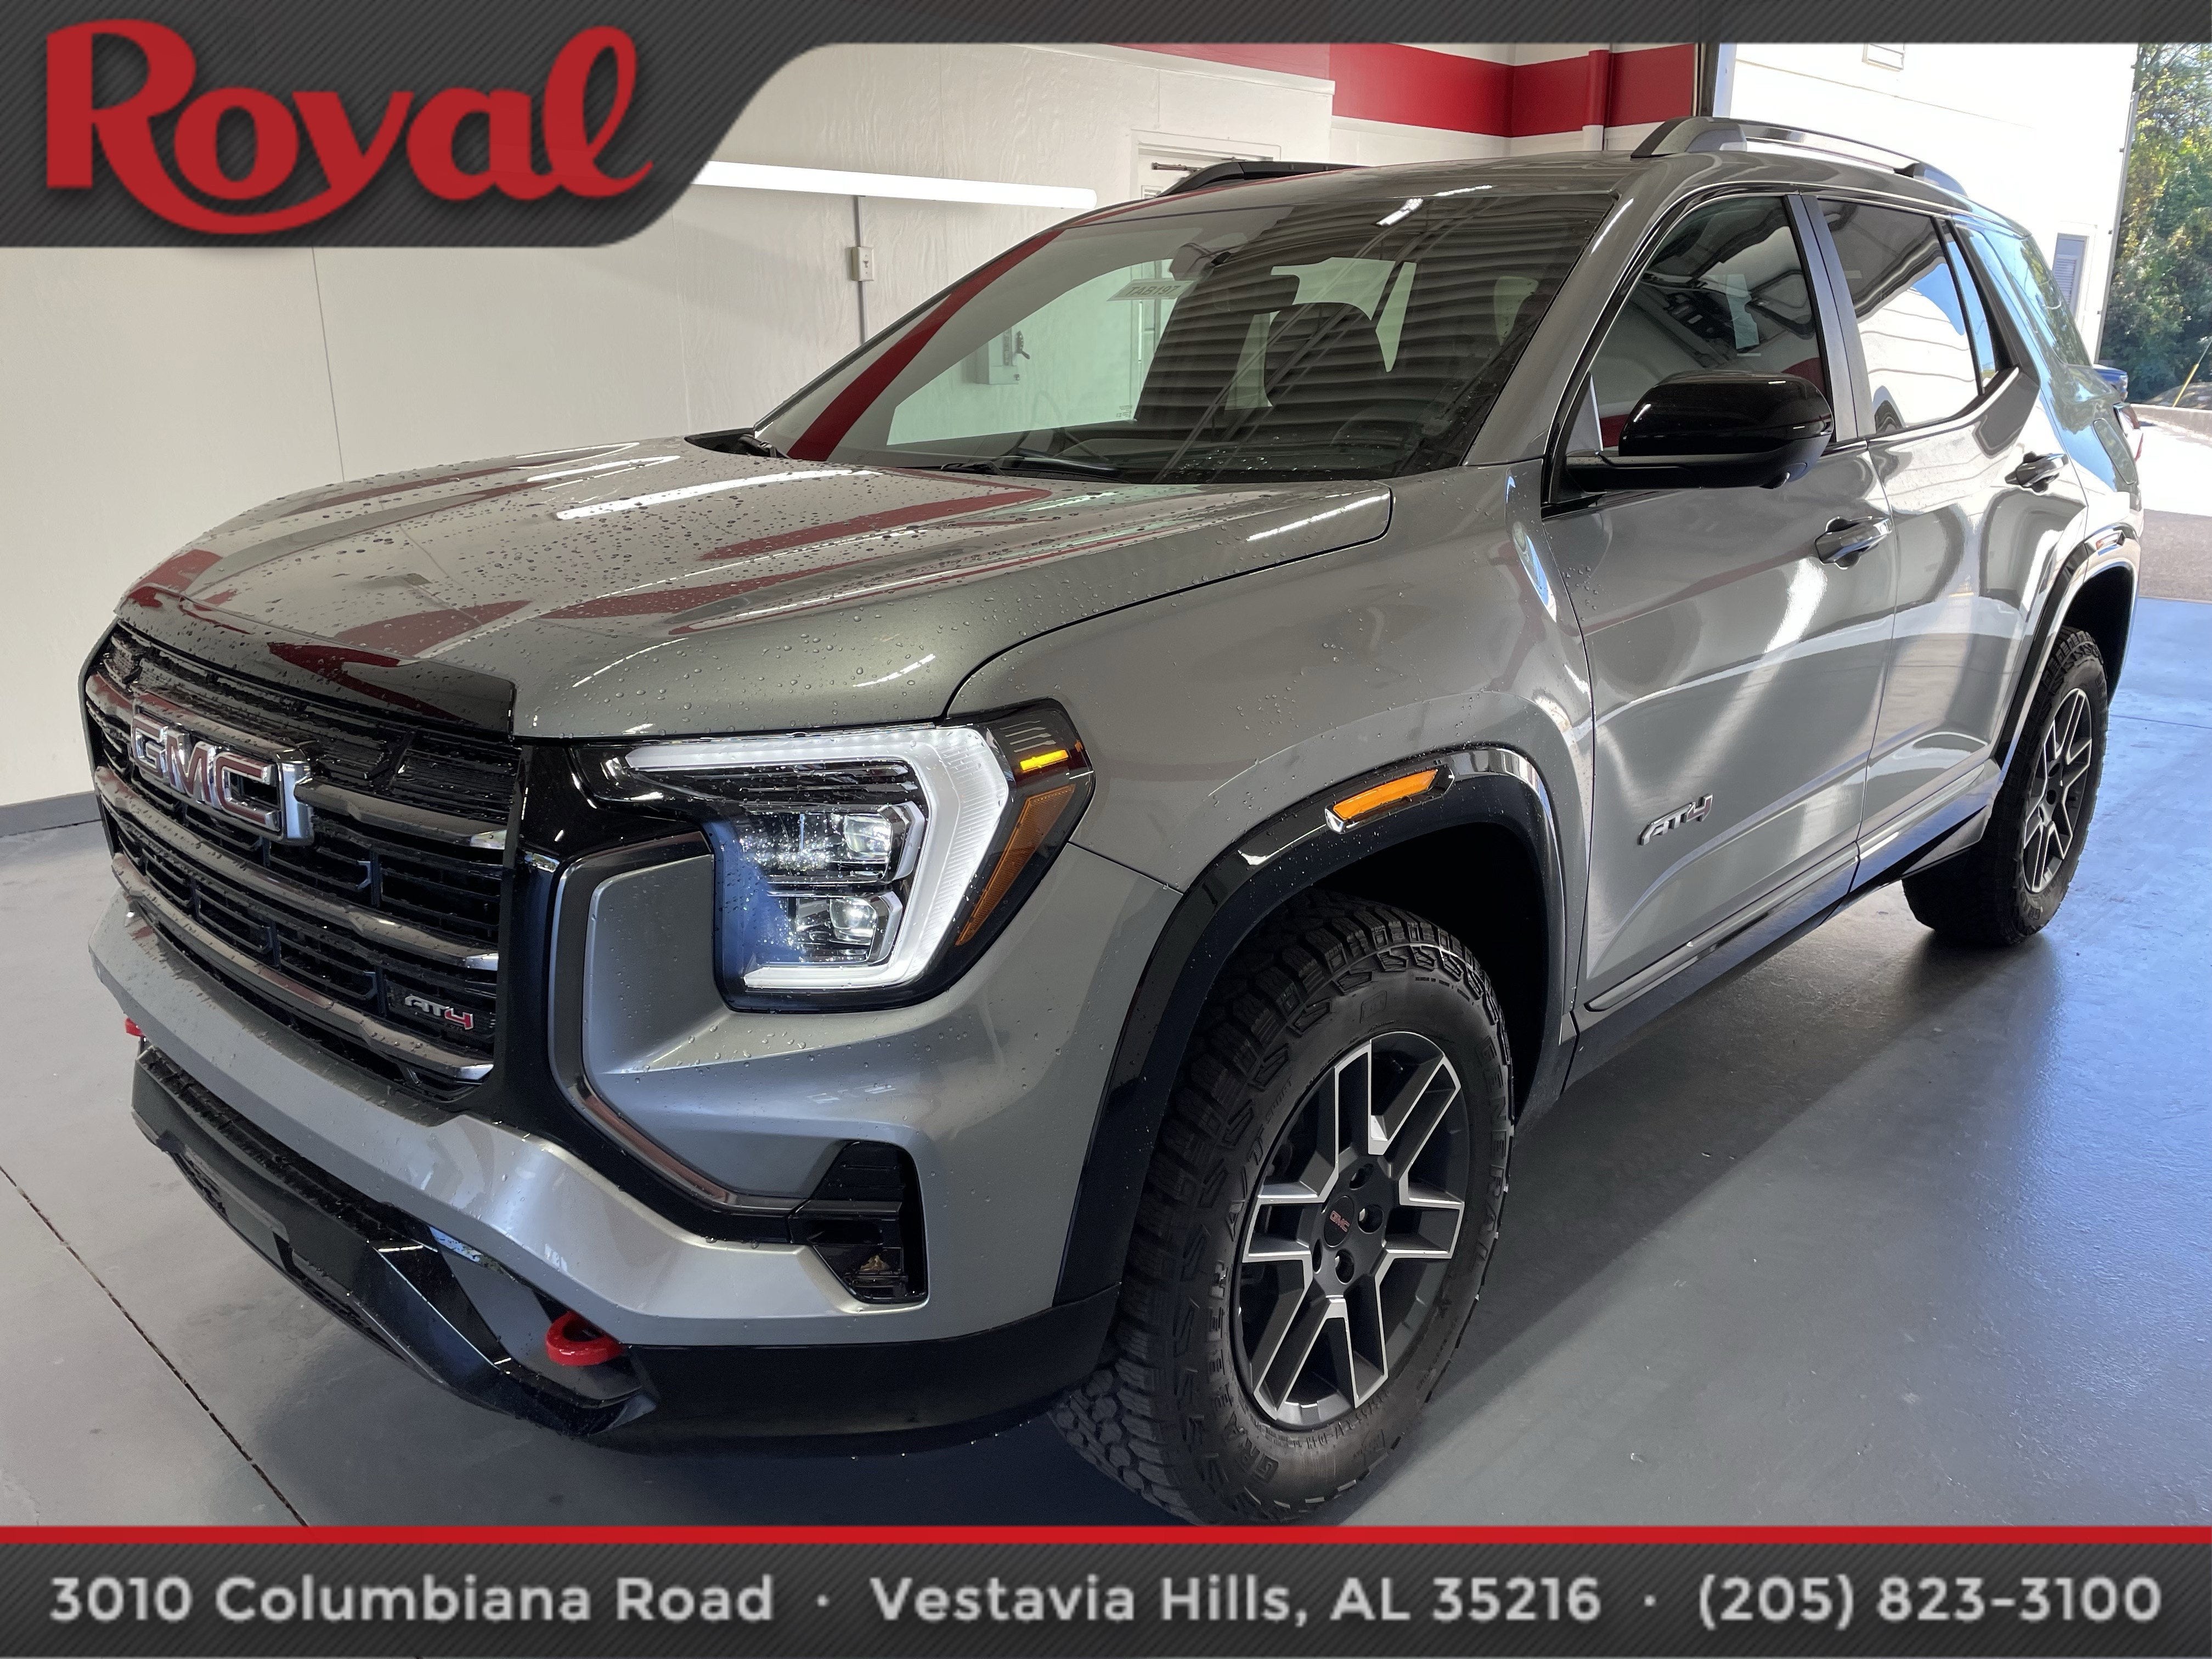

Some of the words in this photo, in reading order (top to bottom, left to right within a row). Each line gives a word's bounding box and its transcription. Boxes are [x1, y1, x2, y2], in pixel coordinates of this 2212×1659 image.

[1125, 285, 1182, 296] TAB197
[131, 714, 280, 831] GMC
[1637, 793, 1713, 846] AT4
[404, 994, 474, 1030] AT4
[1477, 1035, 1507, 1271] GENERAL
[1329, 1210, 1350, 1232] GMC
[1207, 1260, 1279, 1483] GRABBER
